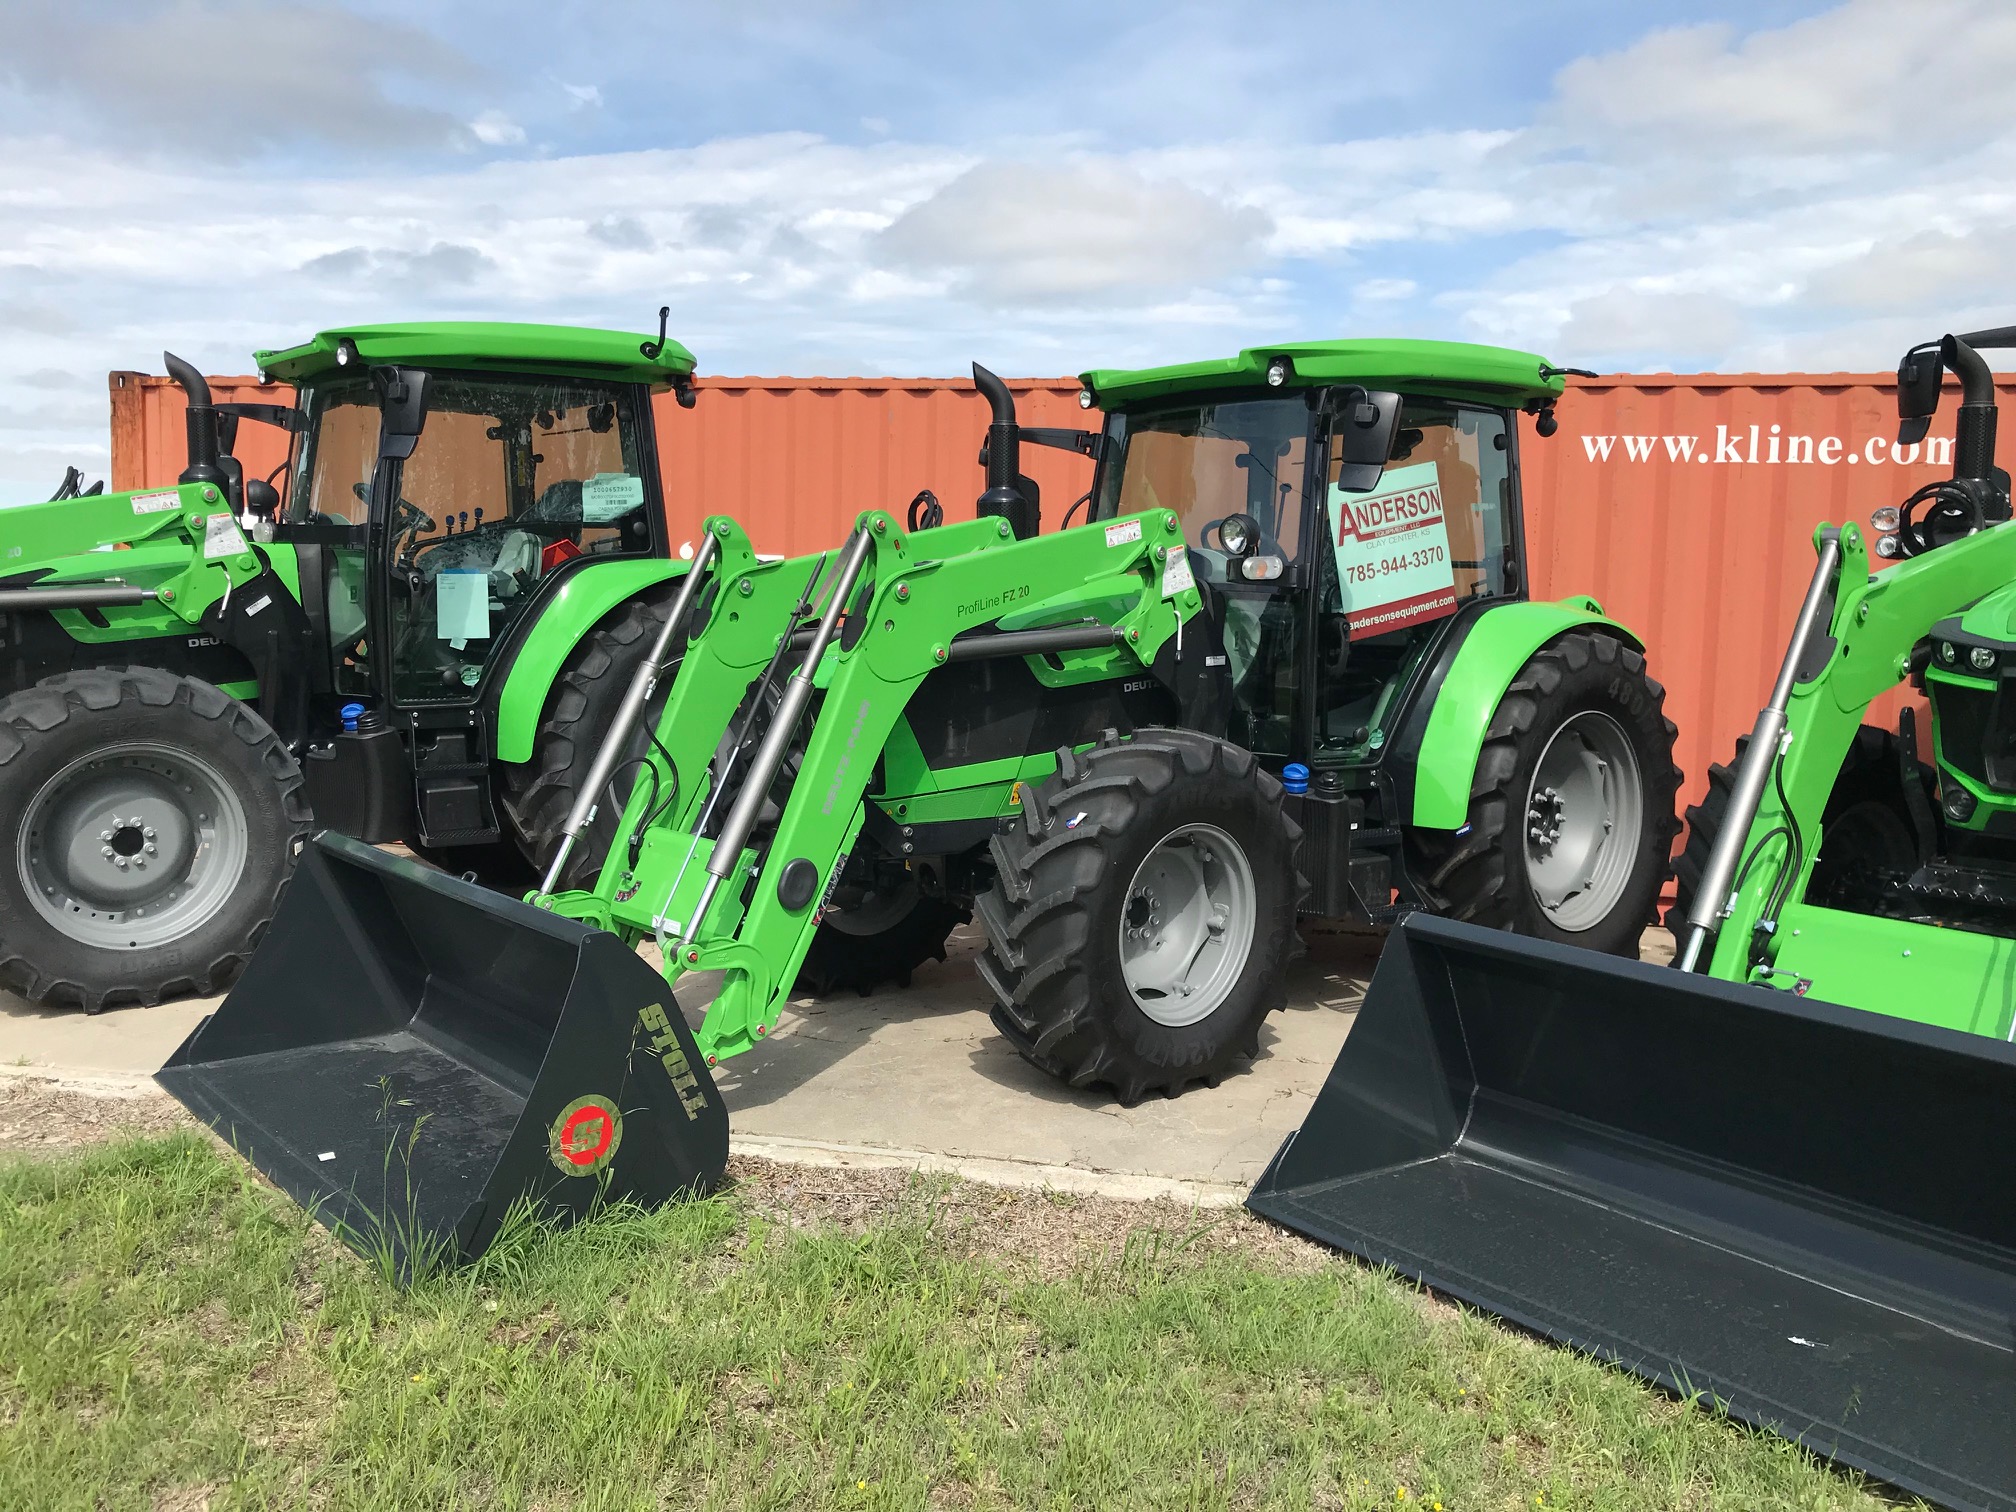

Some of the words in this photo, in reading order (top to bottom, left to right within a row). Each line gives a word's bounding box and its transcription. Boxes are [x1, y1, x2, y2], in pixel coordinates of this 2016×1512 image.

[1581, 425, 1957, 466] www.kline.com
[1337, 488, 1441, 547] ANDERSON
[1410, 521, 1421, 530] LLC
[1366, 539, 1387, 550] CLAY
[1420, 528, 1431, 536] KS
[1346, 545, 1444, 584] 785-944-3370
[957, 597, 1000, 618] ProfiLine
[1002, 589, 1016, 604] FZ
[1018, 585, 1030, 599] 20
[638, 1002, 709, 1122] STOLL
